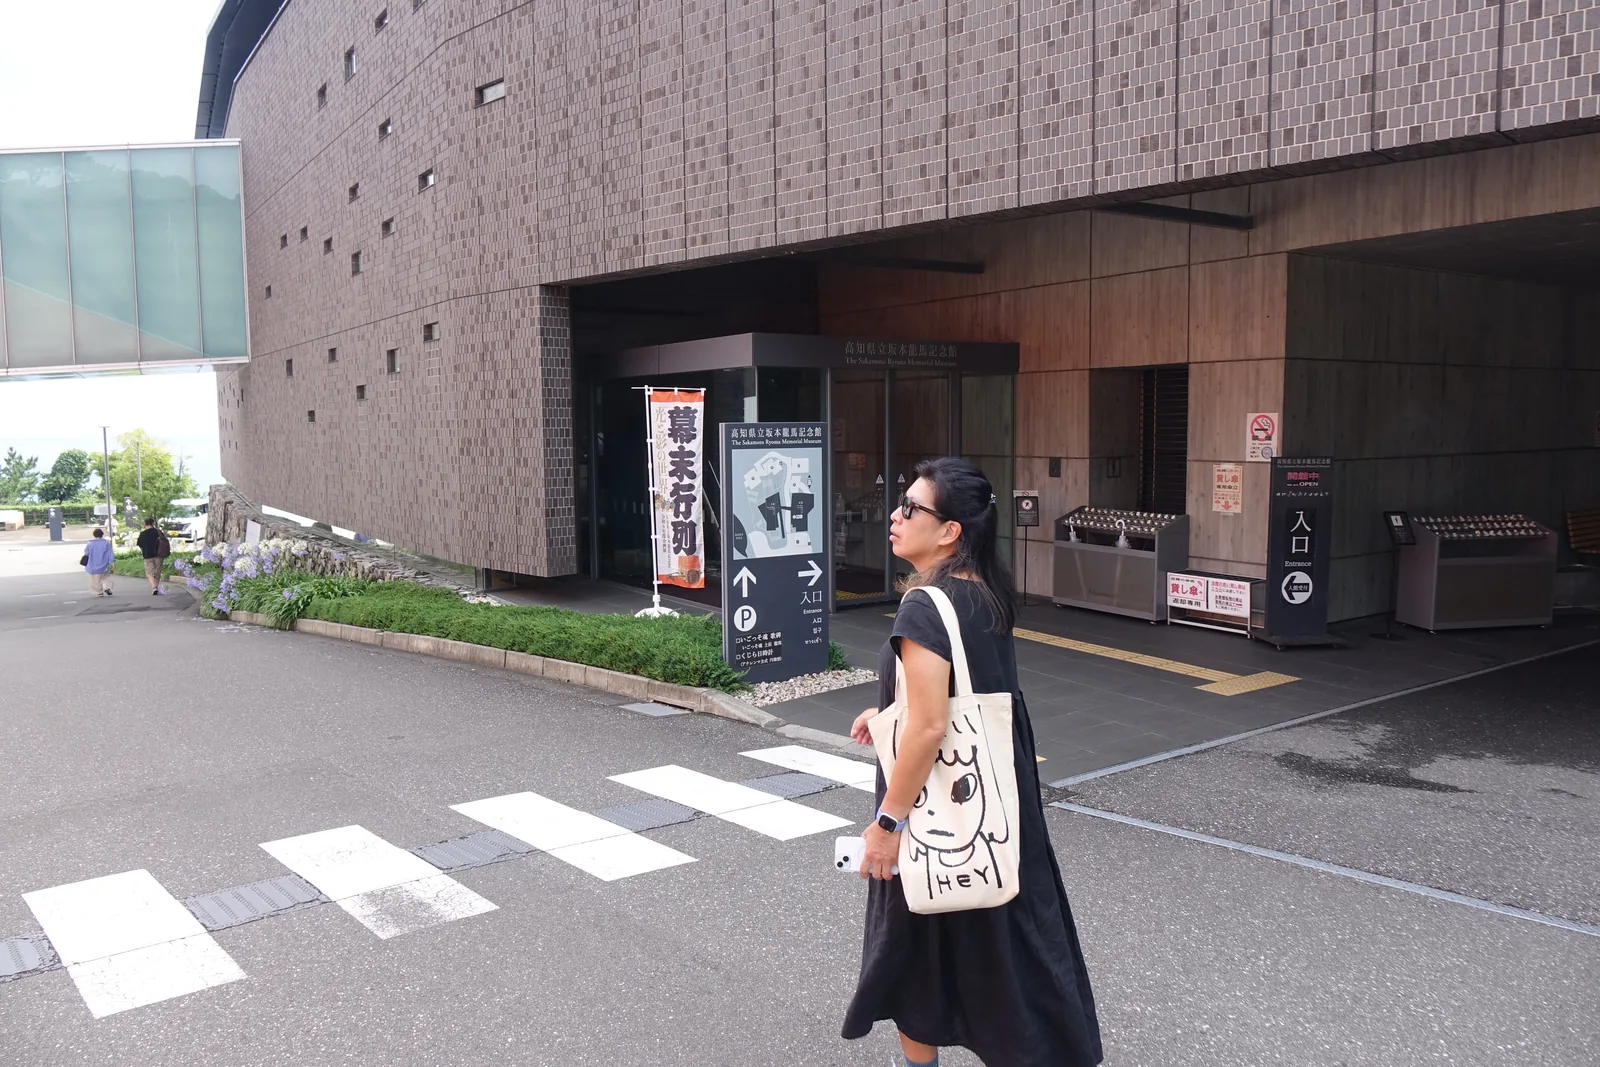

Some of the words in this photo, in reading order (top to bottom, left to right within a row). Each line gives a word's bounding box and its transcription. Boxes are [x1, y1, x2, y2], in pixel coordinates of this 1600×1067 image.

[845, 341, 957, 358] 高知県立坂本龍馬記念館
[858, 357, 886, 365] Sakamoto
[731, 427, 822, 439] 高知県立坂本龍馬記念館
[655, 407, 668, 494] 光と影の世界
[1216, 474, 1239, 483] 貸し傘
[1287, 472, 1319, 480] 開館中
[1290, 510, 1312, 554] 入口
[1171, 583, 1198, 596] 貸し傘
[800, 590, 822, 605] 入口
[1172, 597, 1201, 607] 返却専用
[741, 609, 752, 628] P
[741, 649, 774, 659] くじら日時計
[936, 865, 989, 894] HEY
